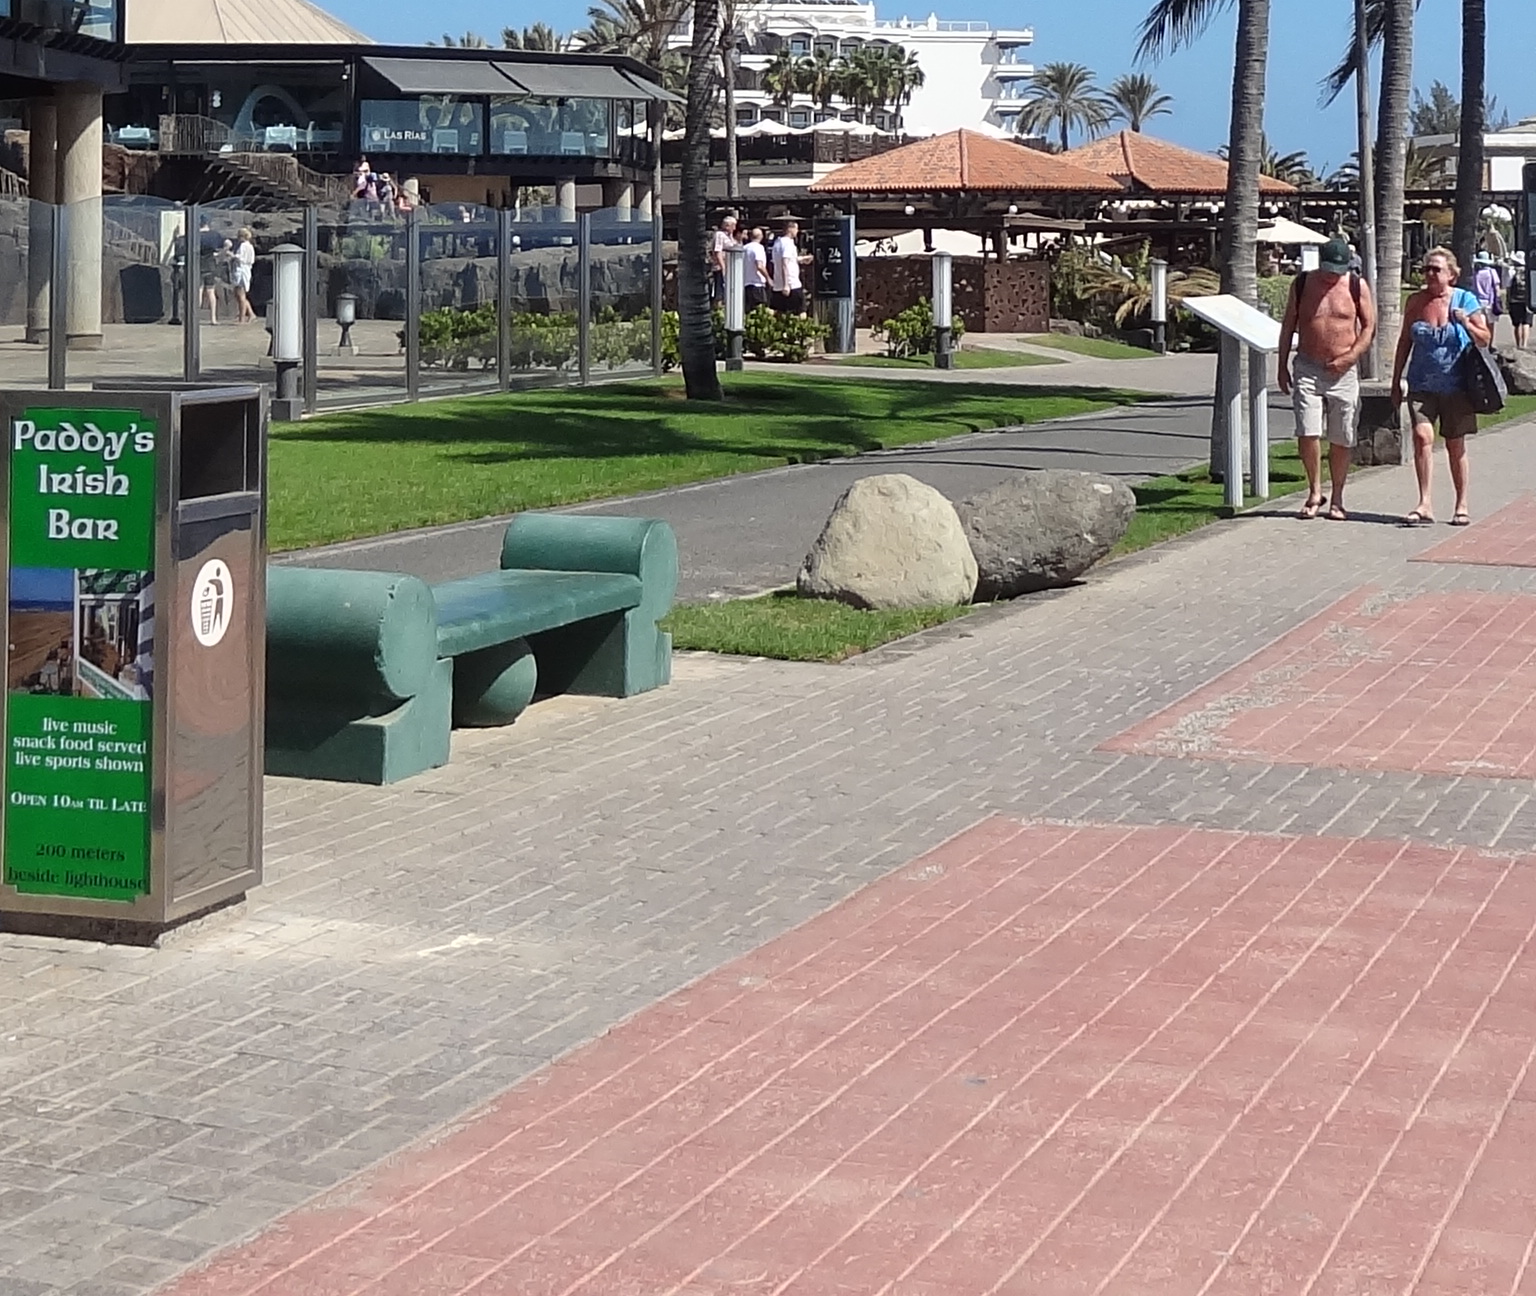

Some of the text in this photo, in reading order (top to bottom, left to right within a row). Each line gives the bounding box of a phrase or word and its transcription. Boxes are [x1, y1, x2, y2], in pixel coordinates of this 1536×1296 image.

[14, 420, 154, 460] Paddy's
[39, 464, 130, 496] Irish
[48, 508, 119, 540] Bar
[43, 717, 118, 735] live music
[13, 735, 147, 754] snack food served
[15, 751, 144, 773] live sports shown
[36, 843, 126, 862] 200 meters
[8, 866, 147, 889] beside lighthouse
